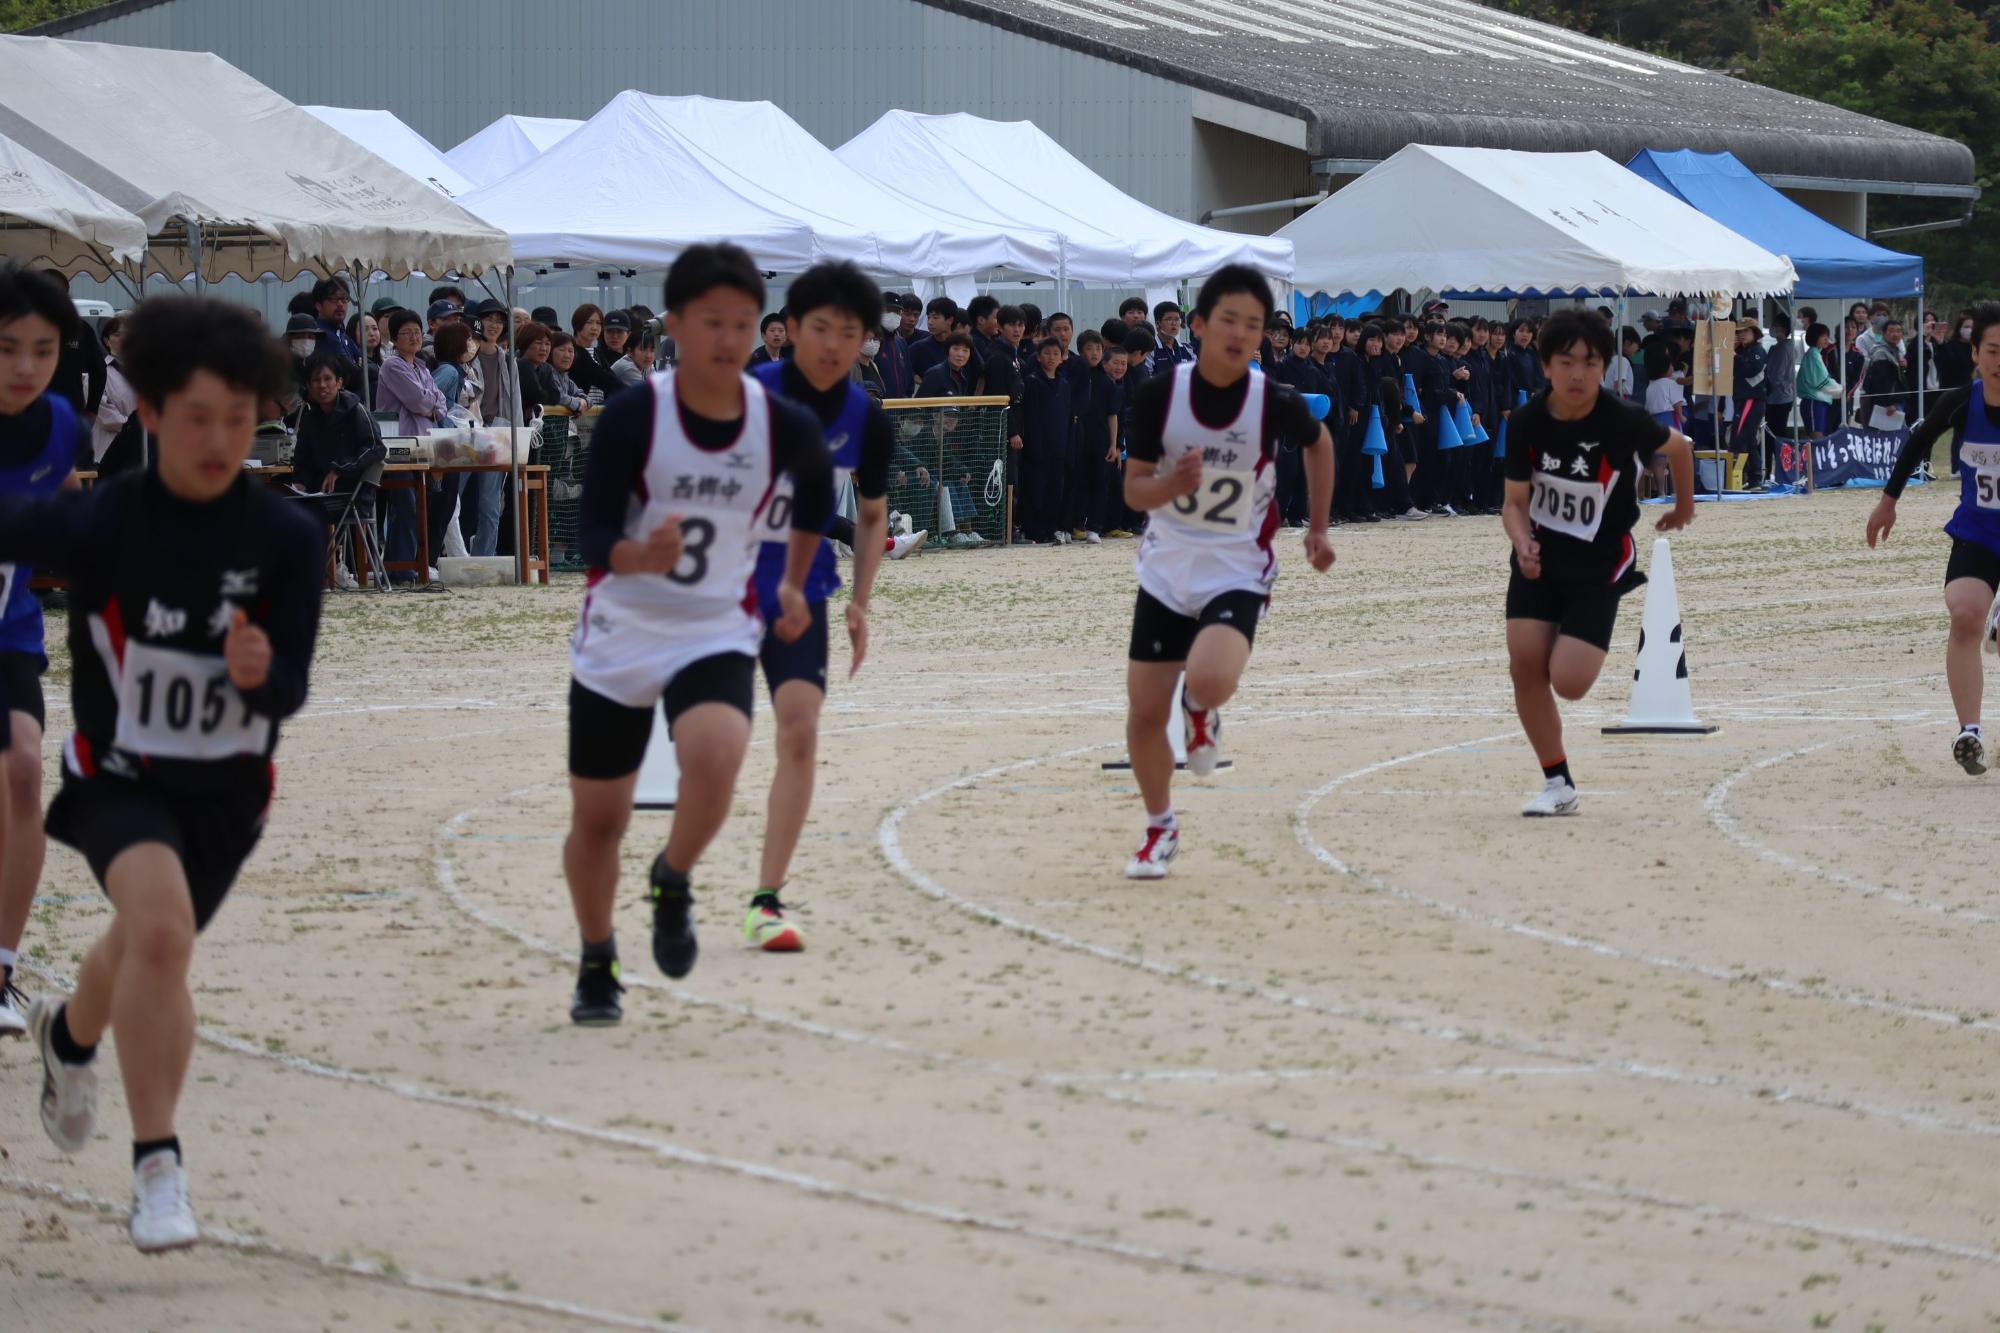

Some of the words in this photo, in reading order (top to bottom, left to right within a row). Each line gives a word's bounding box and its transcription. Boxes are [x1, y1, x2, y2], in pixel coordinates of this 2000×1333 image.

[1184, 445, 1239, 469] 郷中
[1541, 451, 1590, 477] 知夫
[1977, 474, 2000, 503] 5
[136, 669, 252, 735] 105
